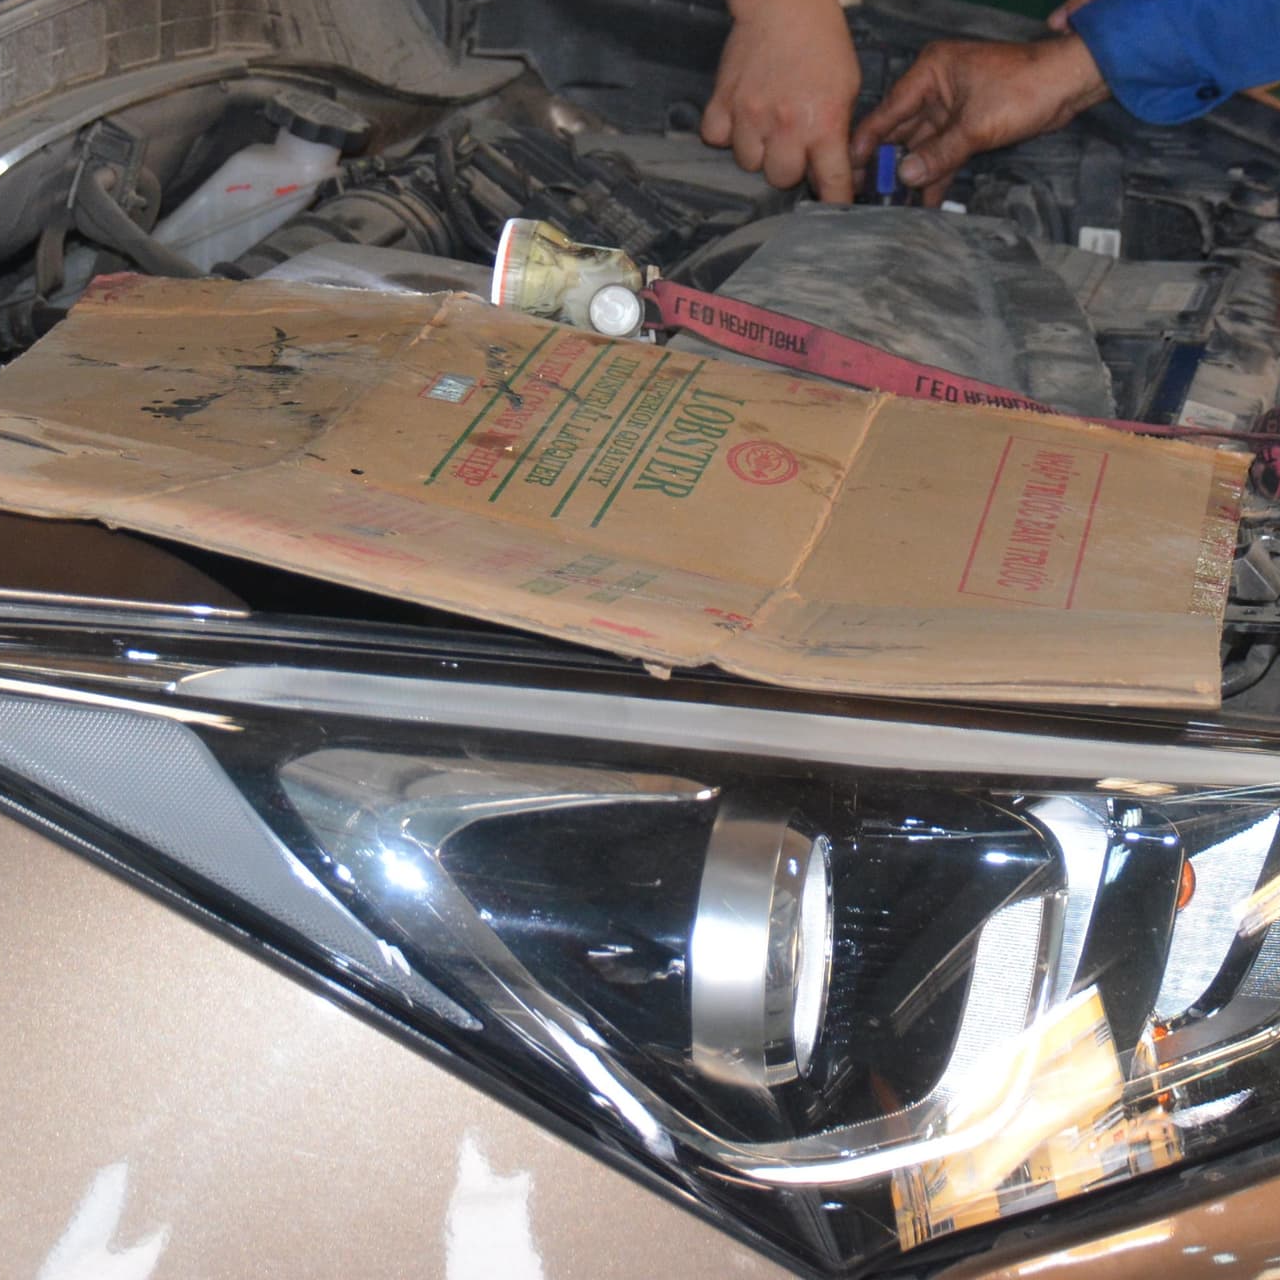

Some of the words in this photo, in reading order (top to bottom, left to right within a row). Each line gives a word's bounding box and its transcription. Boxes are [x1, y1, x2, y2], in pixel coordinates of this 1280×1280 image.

[569, 357, 642, 424] INDUSTRIAL
[624, 376, 680, 430] SUPERIOR
[522, 423, 593, 488] LACQUER
[583, 429, 643, 489] QUALITY
[631, 391, 748, 500] LOBSTER
